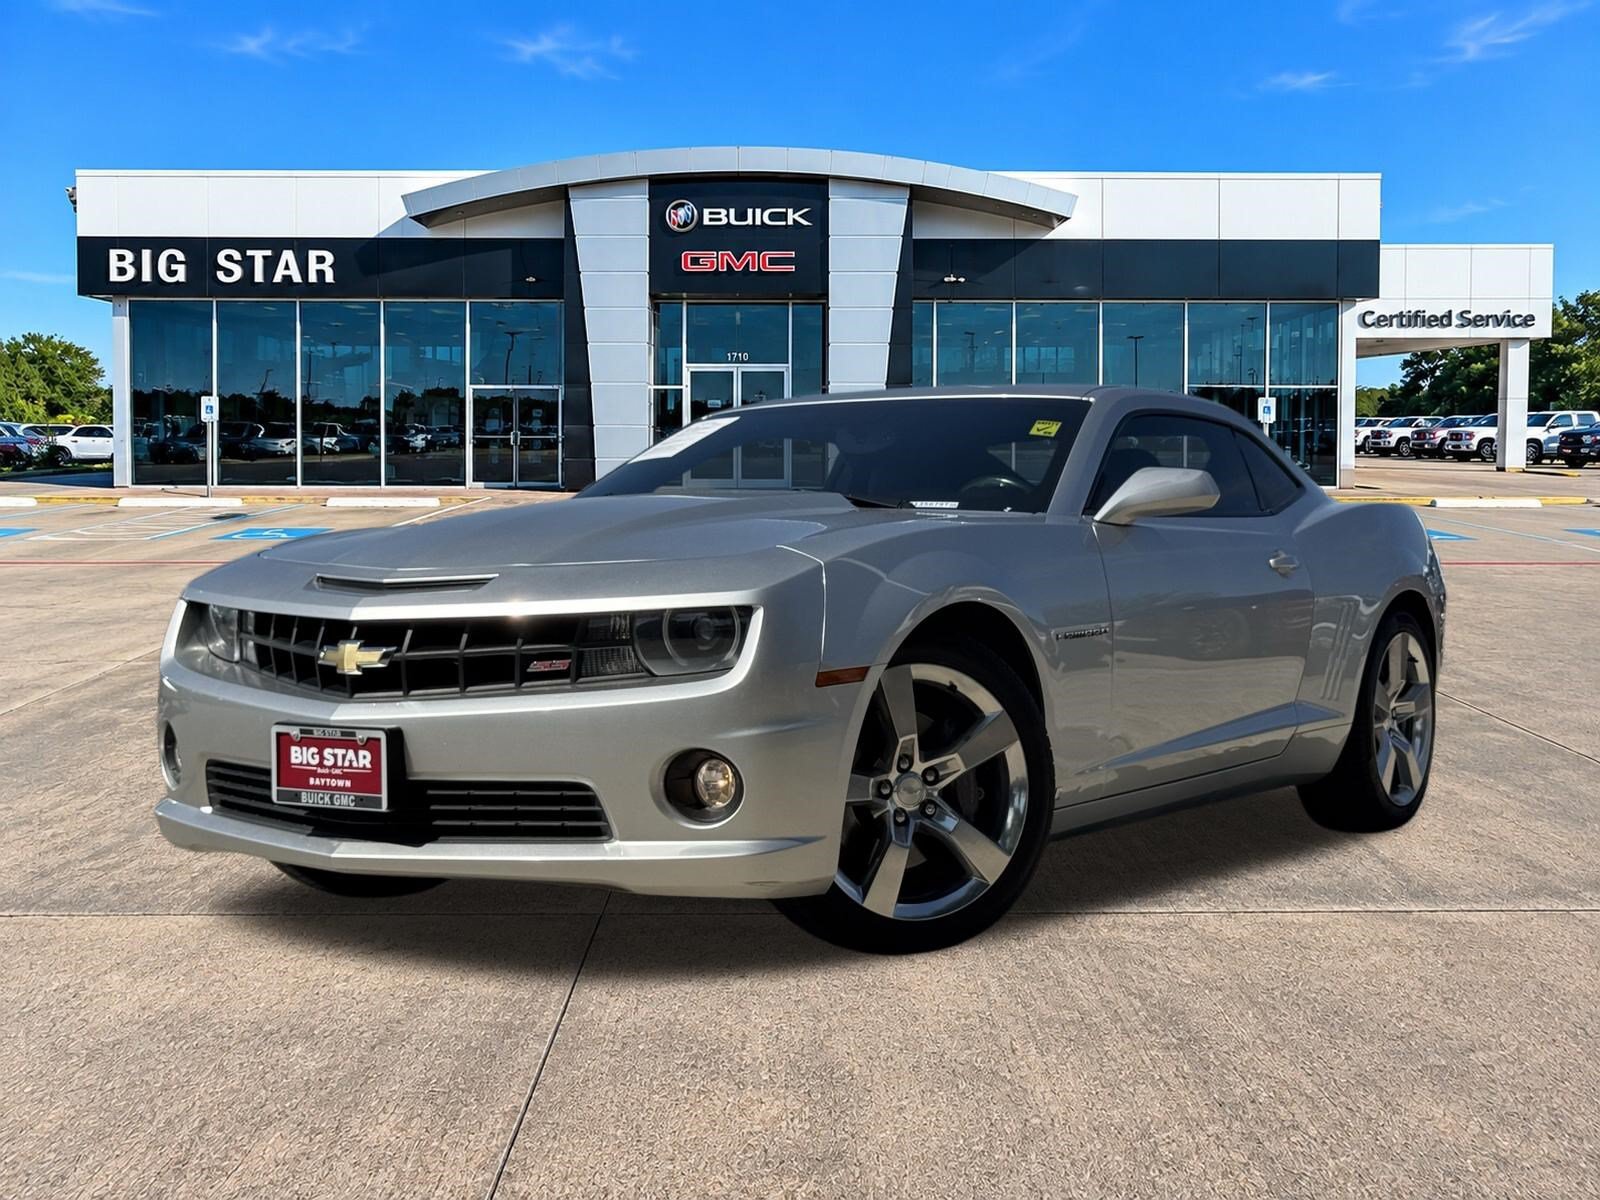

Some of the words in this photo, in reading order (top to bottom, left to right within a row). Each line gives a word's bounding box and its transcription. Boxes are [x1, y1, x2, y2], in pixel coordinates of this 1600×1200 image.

[702, 207, 813, 226] BUICK
[108, 248, 187, 283] BIG
[216, 248, 335, 283] STAR
[681, 251, 795, 272] GMC
[1360, 310, 1453, 329] Certified
[1456, 310, 1536, 329] Service
[727, 352, 749, 362] 1710
[290, 745, 320, 765] BIG
[323, 748, 372, 768] STAR
[309, 777, 352, 787] BAYTOWN
[301, 792, 331, 804] BUICK
[333, 795, 356, 807] GMC
